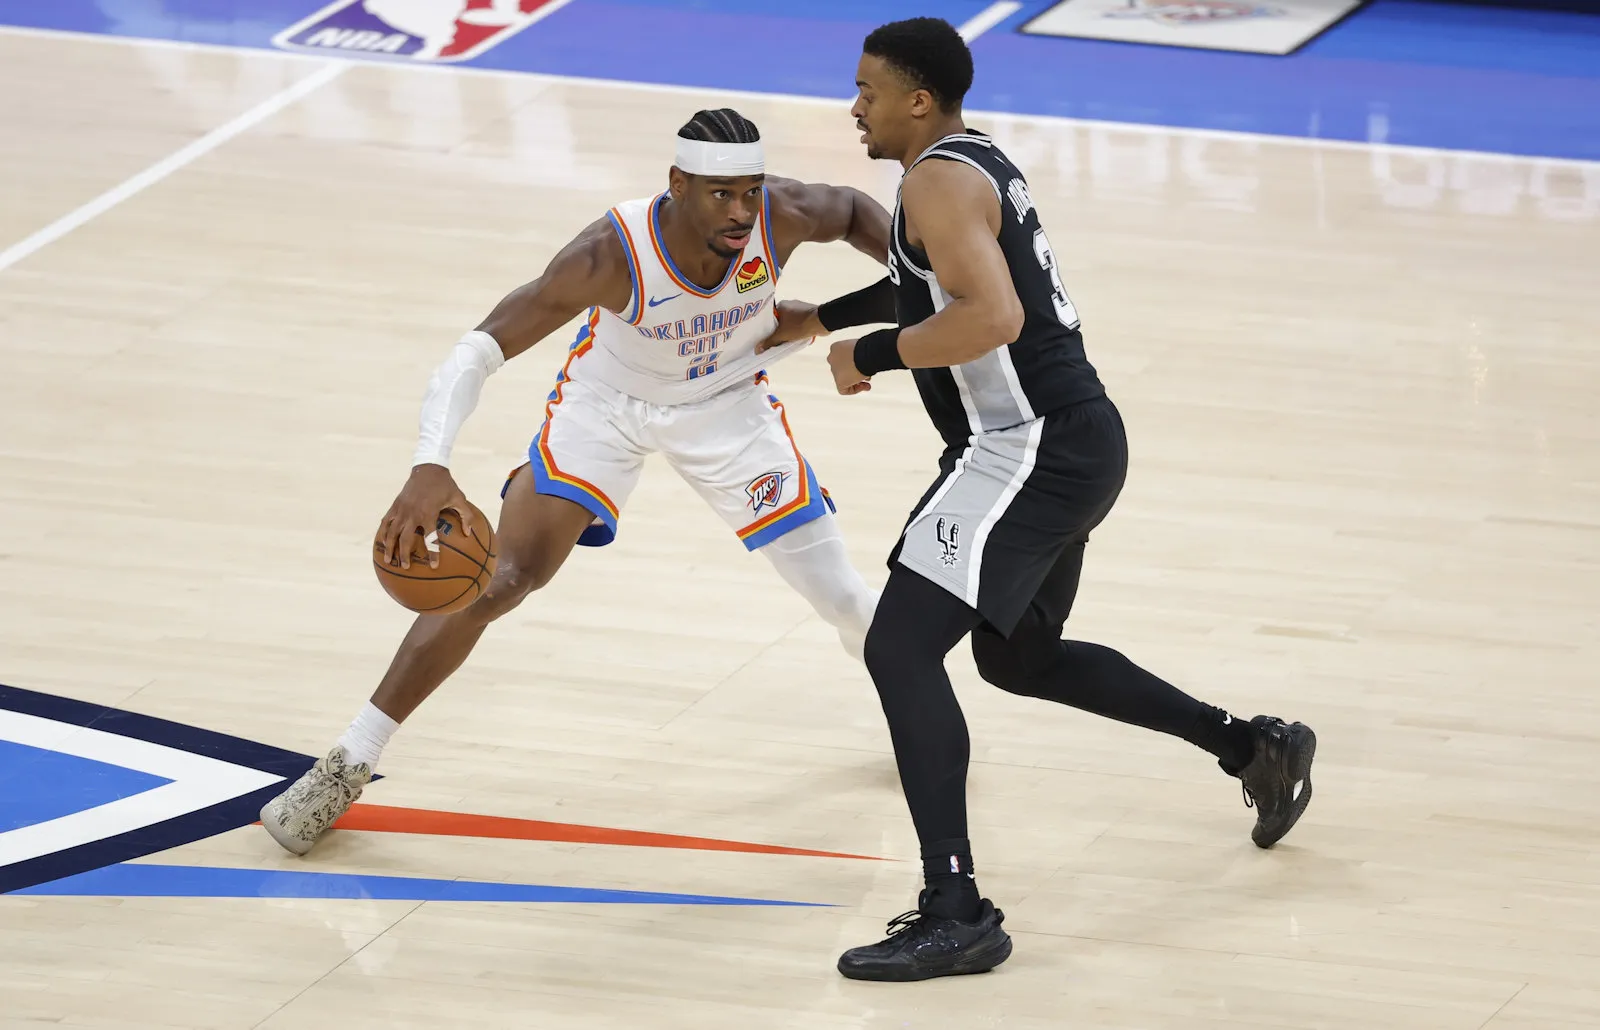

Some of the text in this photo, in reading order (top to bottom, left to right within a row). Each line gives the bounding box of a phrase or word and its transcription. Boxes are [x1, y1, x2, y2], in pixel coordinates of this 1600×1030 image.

[306, 27, 408, 52] NBA
[1033, 226, 1081, 330] 3
[636, 299, 764, 340] OKLAHOM
[678, 327, 736, 357] CITY
[753, 476, 776, 510] OKC
